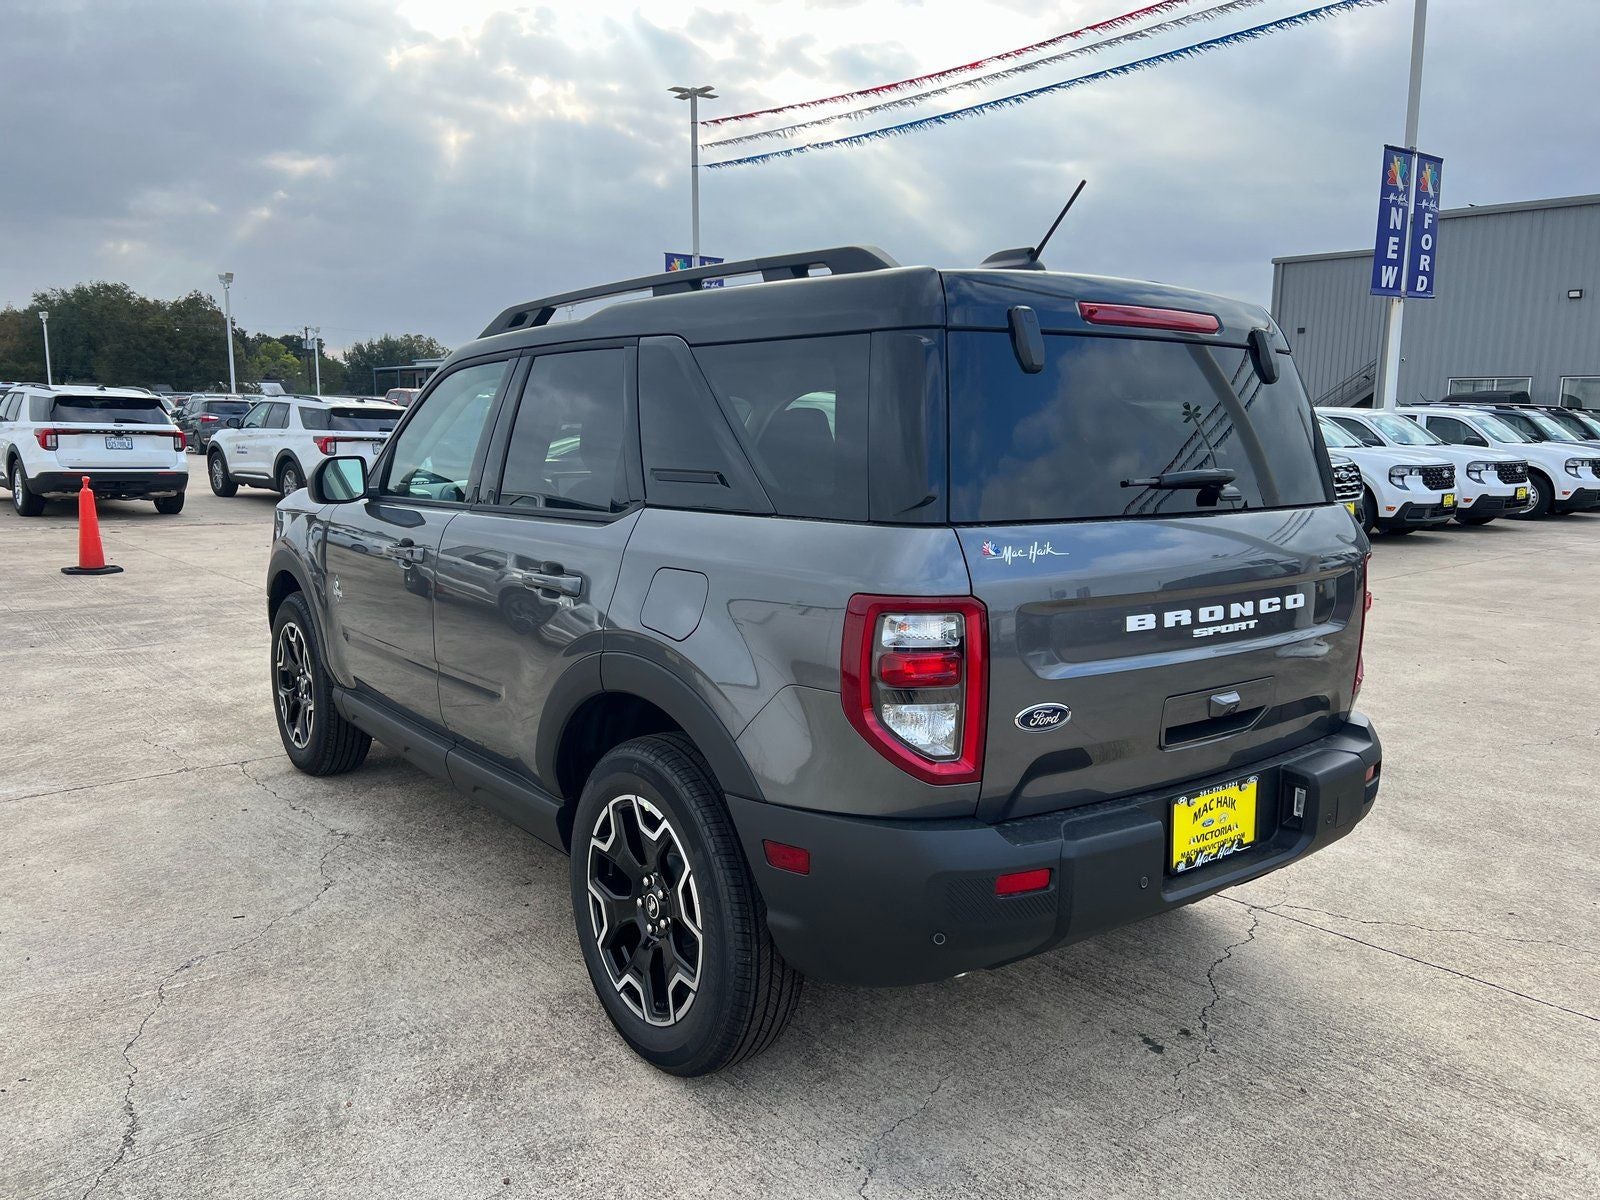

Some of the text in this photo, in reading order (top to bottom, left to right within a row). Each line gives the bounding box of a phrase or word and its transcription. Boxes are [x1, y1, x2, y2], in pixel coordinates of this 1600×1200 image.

[1380, 207, 1403, 289] NEW
[1415, 213, 1434, 292] FORD
[992, 541, 1070, 566] Mac Haik
[1126, 593, 1305, 632] BRONCO
[1192, 619, 1259, 638] SPORT
[1193, 799, 1214, 824] MAC
[1216, 796, 1236, 811] HAIK
[1196, 824, 1233, 843] VICTORIA
[1188, 840, 1251, 868] Mac Haik
